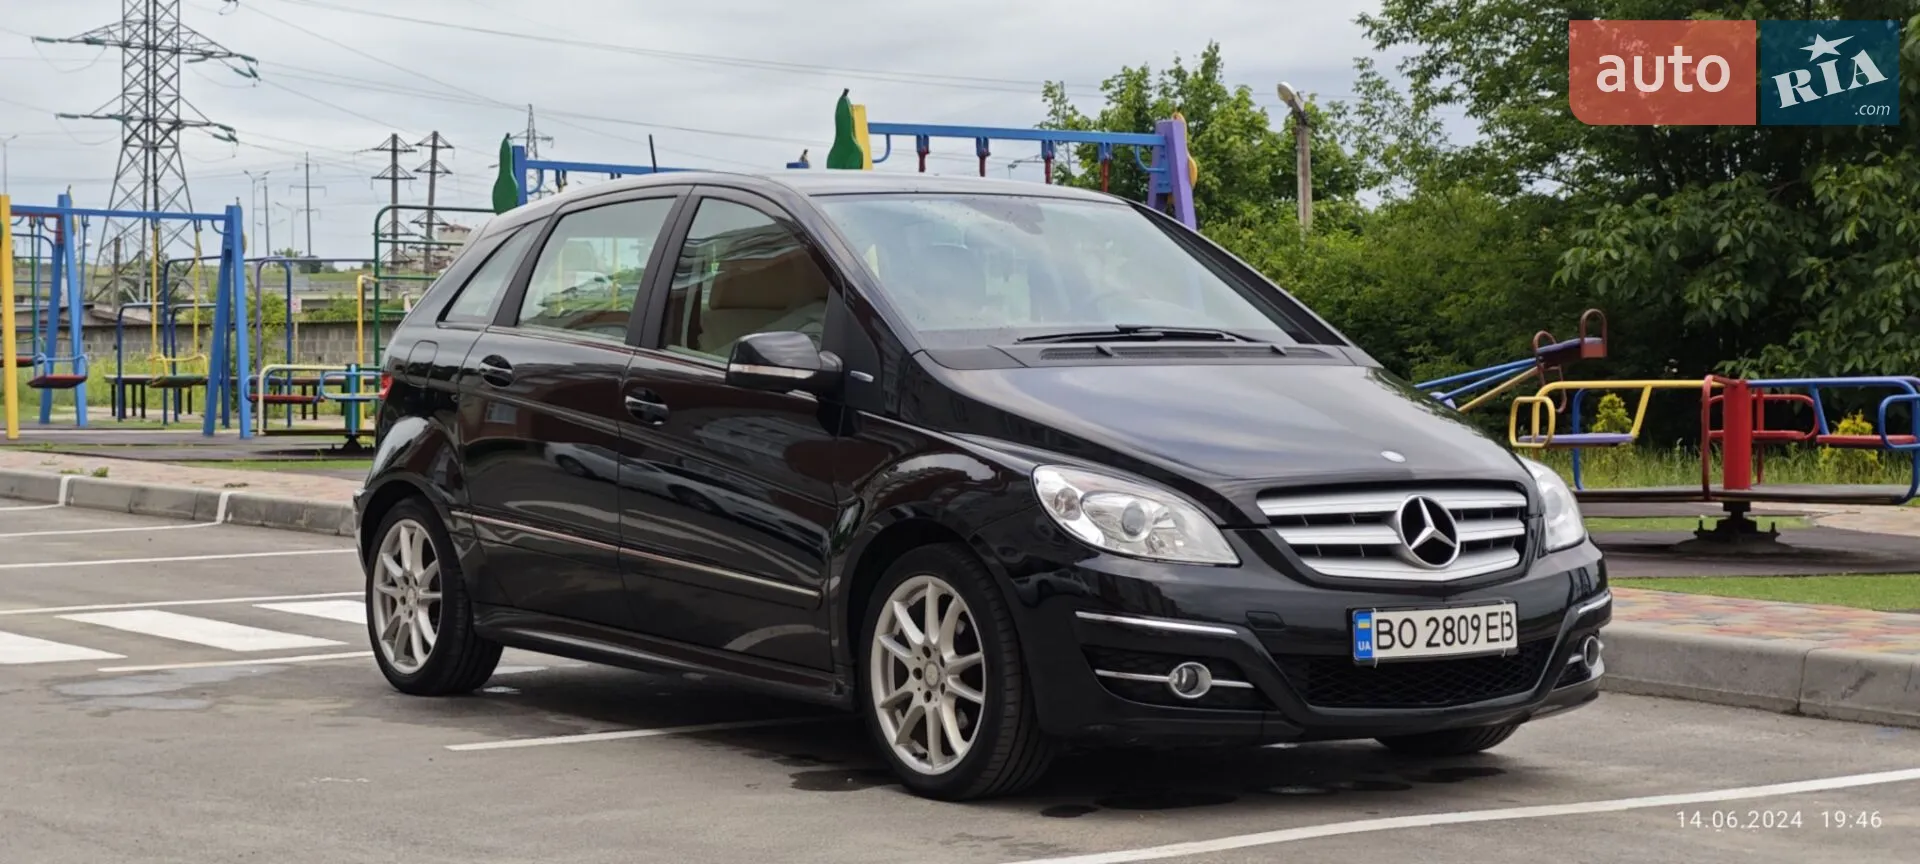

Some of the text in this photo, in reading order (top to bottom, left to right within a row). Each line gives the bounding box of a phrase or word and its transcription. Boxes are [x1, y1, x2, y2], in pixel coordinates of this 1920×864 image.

[1376, 611, 1514, 650] BO 2809 EB
[1358, 641, 1372, 651] UA
